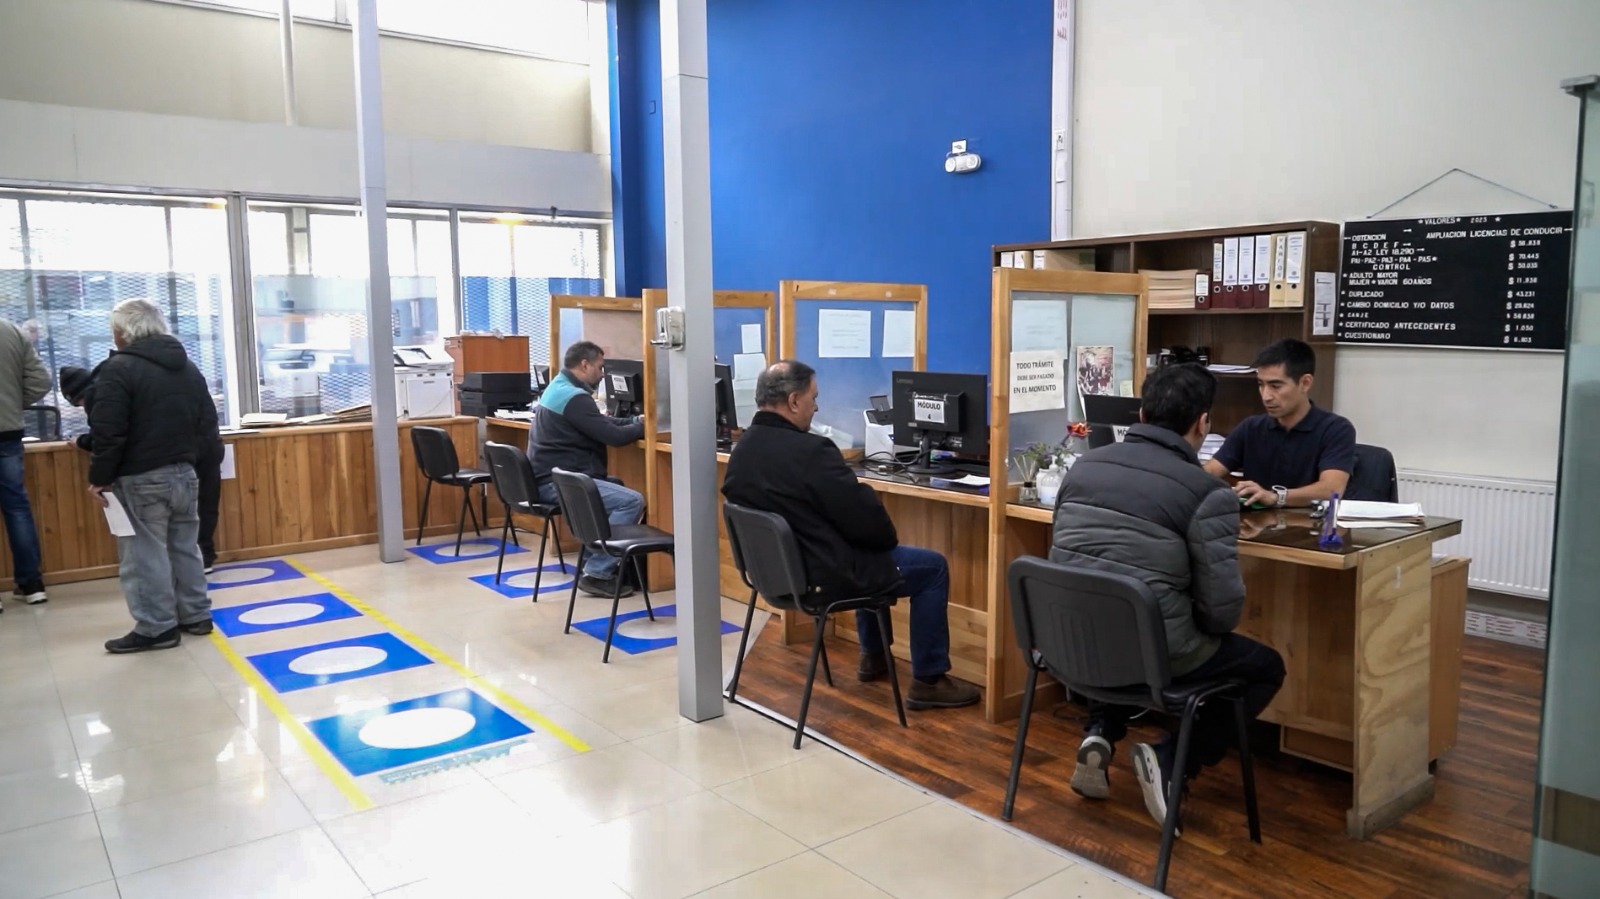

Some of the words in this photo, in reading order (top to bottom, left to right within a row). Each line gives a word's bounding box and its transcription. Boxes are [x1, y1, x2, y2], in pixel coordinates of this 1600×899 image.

[1424, 217, 1456, 225] VALORES
[1524, 227, 1562, 235] CONDUCIR
[1016, 362, 1031, 370] TODO
[1029, 384, 1057, 392] MOMENTO
[917, 401, 941, 410] MÓDULO
